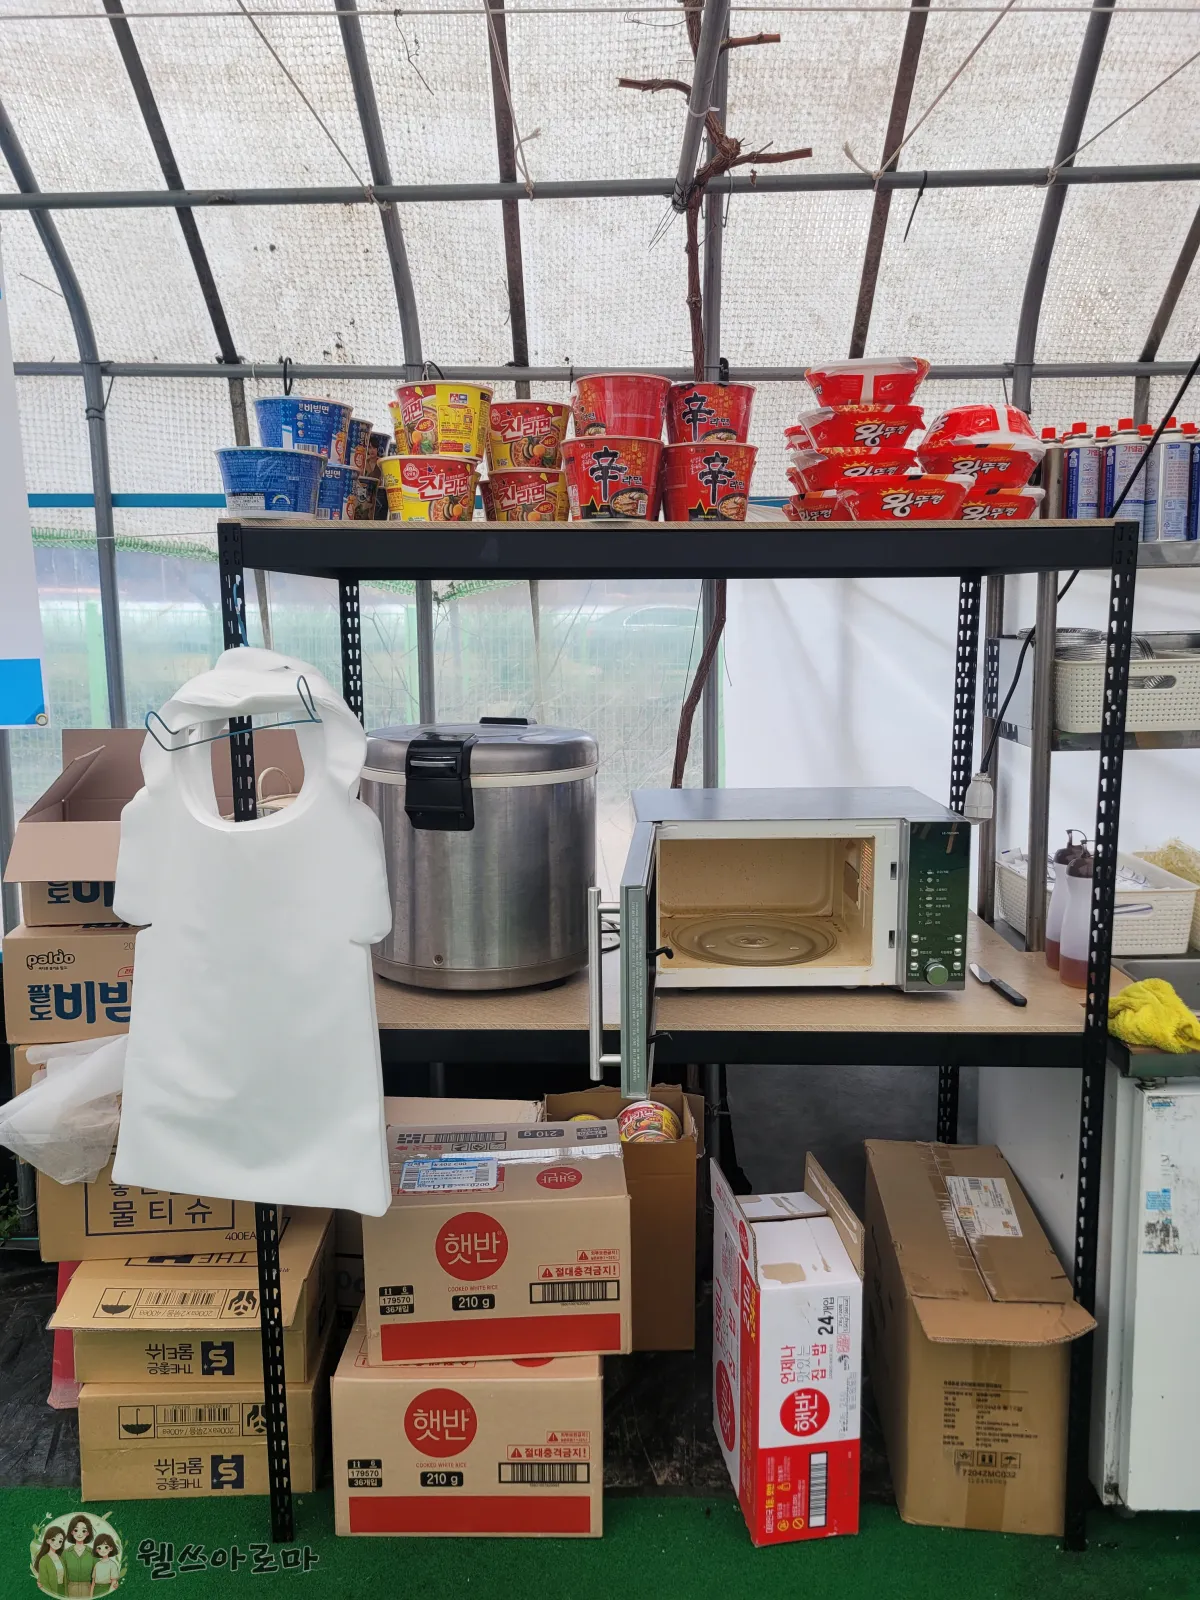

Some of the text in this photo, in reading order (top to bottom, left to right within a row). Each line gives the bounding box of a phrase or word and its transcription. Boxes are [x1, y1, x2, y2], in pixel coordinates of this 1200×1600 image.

[304, 403, 329, 415] 비빔면
[681, 391, 715, 442] 辛
[500, 414, 552, 443] 진라면
[709, 417, 731, 426] 라면
[853, 422, 909, 447] 왕뚜껑
[1122, 445, 1145, 453] 가열금
[321, 469, 341, 479] 빔면
[589, 446, 628, 502] 辛
[622, 475, 642, 485] 라면
[698, 451, 735, 506] 辛
[418, 473, 469, 502] 진라면
[498, 483, 547, 511] 진라면
[882, 491, 945, 517] 왕뚜껑
[47, 881, 70, 904] 도
[26, 949, 75, 970] paldo
[27, 984, 53, 1020] 팔도
[541, 1171, 578, 1184] 햇반
[109, 1198, 213, 1228] 물티슈
[225, 1231, 256, 1241] 400EA
[444, 1231, 500, 1265] 햇반
[382, 1296, 411, 1305] 179570
[385, 1305, 410, 1314] 36개입
[458, 1296, 490, 1308] 210 g
[817, 1297, 835, 1336] 24개입
[145, 1343, 194, 1361] 물티슈
[780, 1345, 796, 1385] 언제나
[797, 1345, 811, 1384] 맛있는
[794, 1391, 818, 1433] 햇반
[412, 1409, 470, 1441] 햇반
[154, 1457, 204, 1476] 물티슈
[351, 1470, 379, 1478] 179570
[426, 1473, 459, 1486] 210 g
